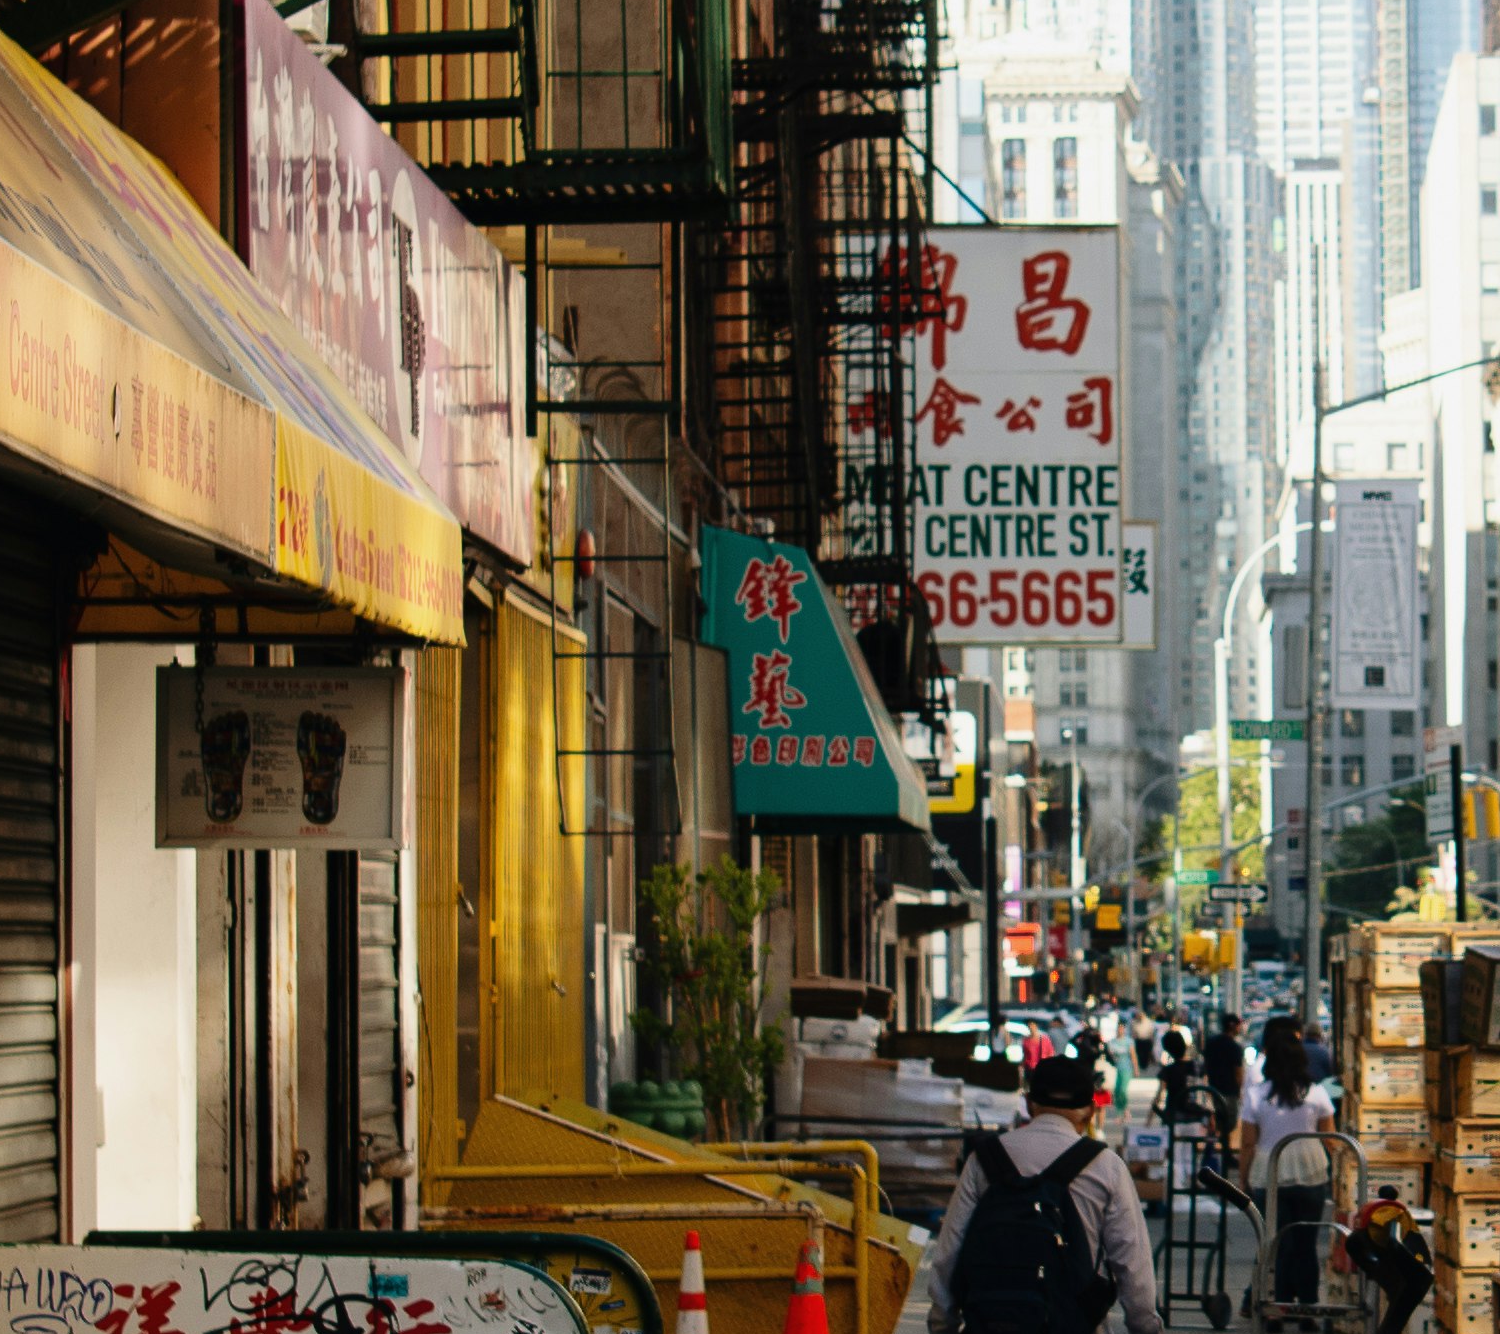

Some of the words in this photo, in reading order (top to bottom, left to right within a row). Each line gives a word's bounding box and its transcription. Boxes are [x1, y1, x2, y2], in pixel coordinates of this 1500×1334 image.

[8, 297, 61, 420] Centre
[846, 376, 1113, 449] 食公司
[964, 465, 1118, 507] CENTRE
[925, 513, 1058, 558] CENTRE
[1068, 513, 1116, 558] ST.
